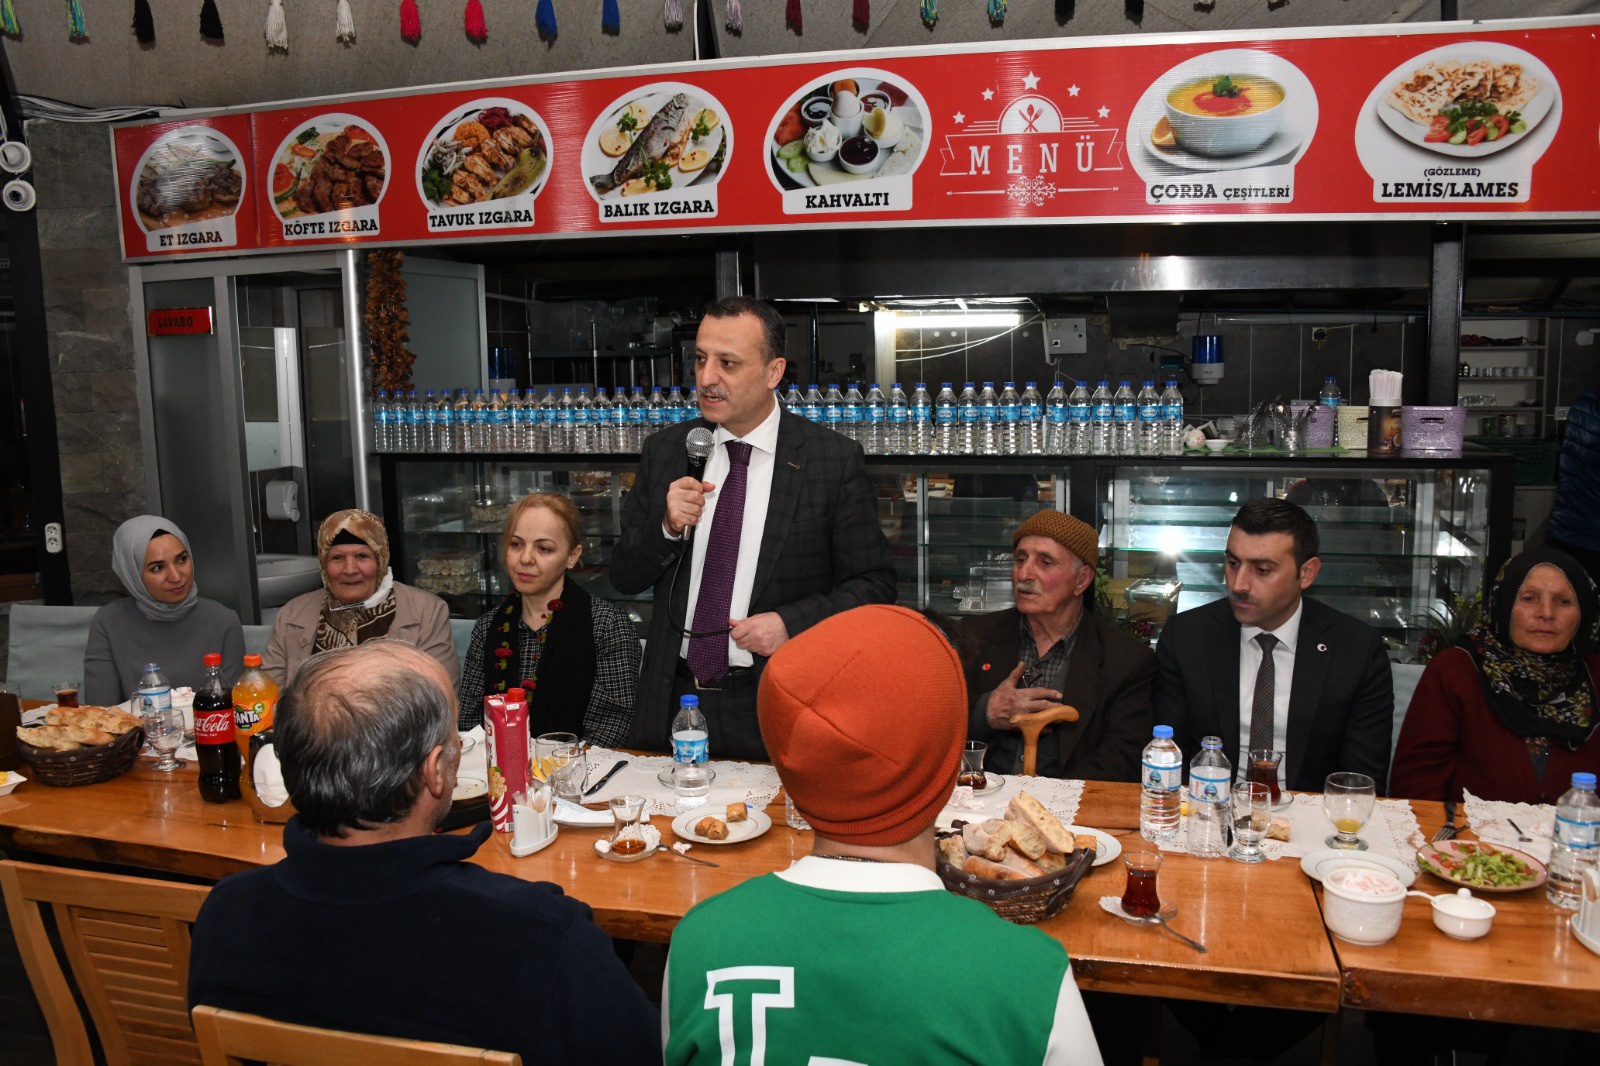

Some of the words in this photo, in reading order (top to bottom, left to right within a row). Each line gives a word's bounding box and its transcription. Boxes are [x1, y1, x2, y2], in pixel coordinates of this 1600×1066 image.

[968, 134, 1096, 176] MENÜ
[1423, 167, 1481, 178] (GÖZLEME)
[1150, 184, 1218, 204] ÇORBA
[1222, 185, 1290, 200] ÇEŞİTLERİ
[1381, 178, 1519, 198] LEMİS/LAMES
[603, 202, 650, 218] BALIK
[653, 199, 715, 216] IZGARA
[805, 192, 890, 209] KAHVALTI
[284, 220, 326, 236] KÖFTE
[328, 218, 379, 234] IZGARA
[428, 212, 475, 228] TAVUK
[478, 209, 534, 225] IZGARA
[159, 234, 174, 247] ET
[177, 230, 223, 246] IZGARA
[158, 315, 194, 329] LAVABO
